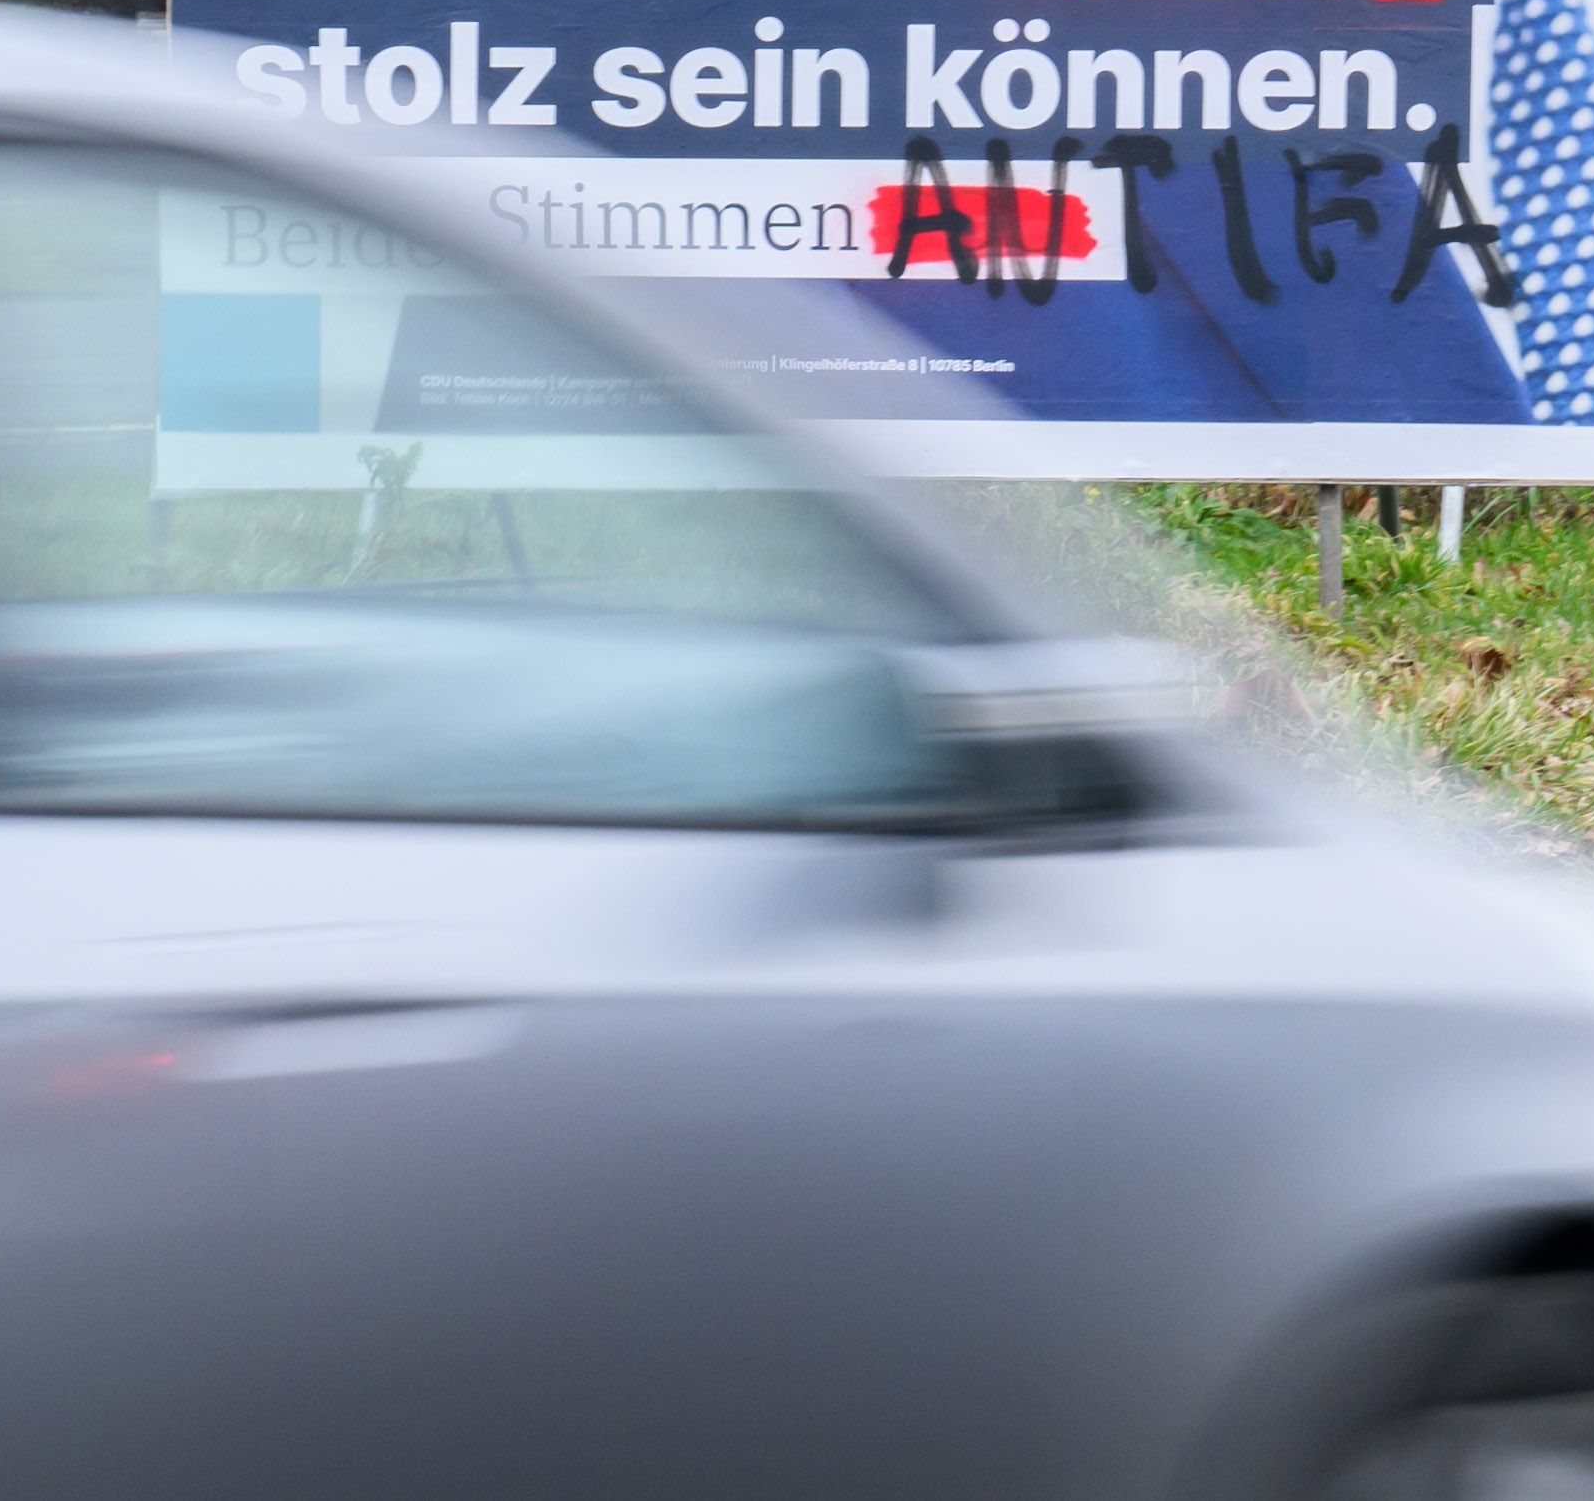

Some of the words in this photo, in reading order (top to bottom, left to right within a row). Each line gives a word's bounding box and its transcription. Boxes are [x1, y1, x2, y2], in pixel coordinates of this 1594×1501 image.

[235, 21, 557, 126] stolz
[591, 16, 869, 129] sein
[905, 17, 1437, 132] können.
[487, 182, 860, 252] Stimmen
[888, 123, 1511, 307] ANTIFA
[778, 356, 905, 373] Klingelhöferstraße
